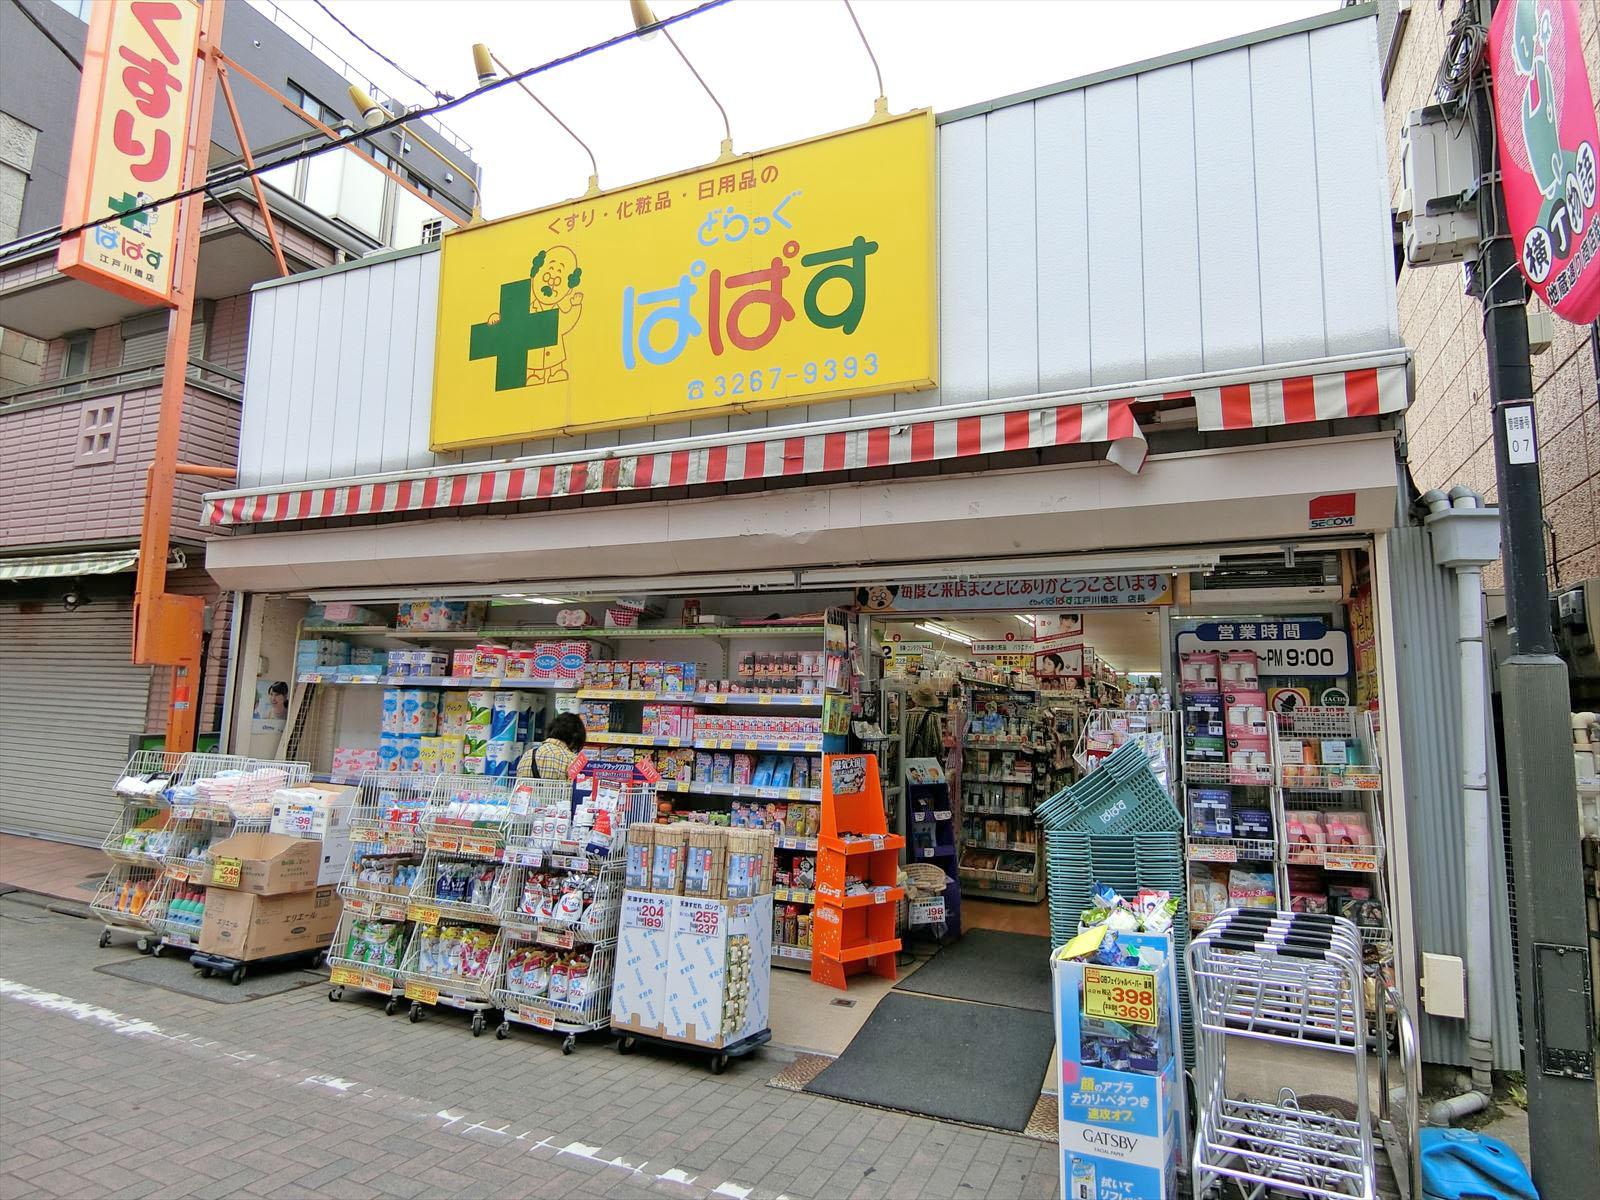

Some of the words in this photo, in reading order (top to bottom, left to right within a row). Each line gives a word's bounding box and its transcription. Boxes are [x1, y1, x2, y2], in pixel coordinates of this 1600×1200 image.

[113, 1, 183, 182] くすり
[697, 190, 803, 247] どらっぐ
[99, 253, 155, 283] 江戸川橋店
[622, 235, 879, 370] ぱぱす
[713, 352, 879, 398] 3267-9393
[1311, 516, 1353, 528] SECOM
[1217, 623, 1301, 641] 営業時間
[1286, 648, 1334, 667] 9:00
[223, 866, 239, 876] 248
[285, 911, 318, 922] エリエール
[641, 905, 664, 918] 204
[695, 911, 719, 924] 255
[1112, 987, 1153, 1006] 398
[1081, 1076, 1134, 1094] 顔のアブラ
[1082, 1128, 1138, 1152] GATSBY
